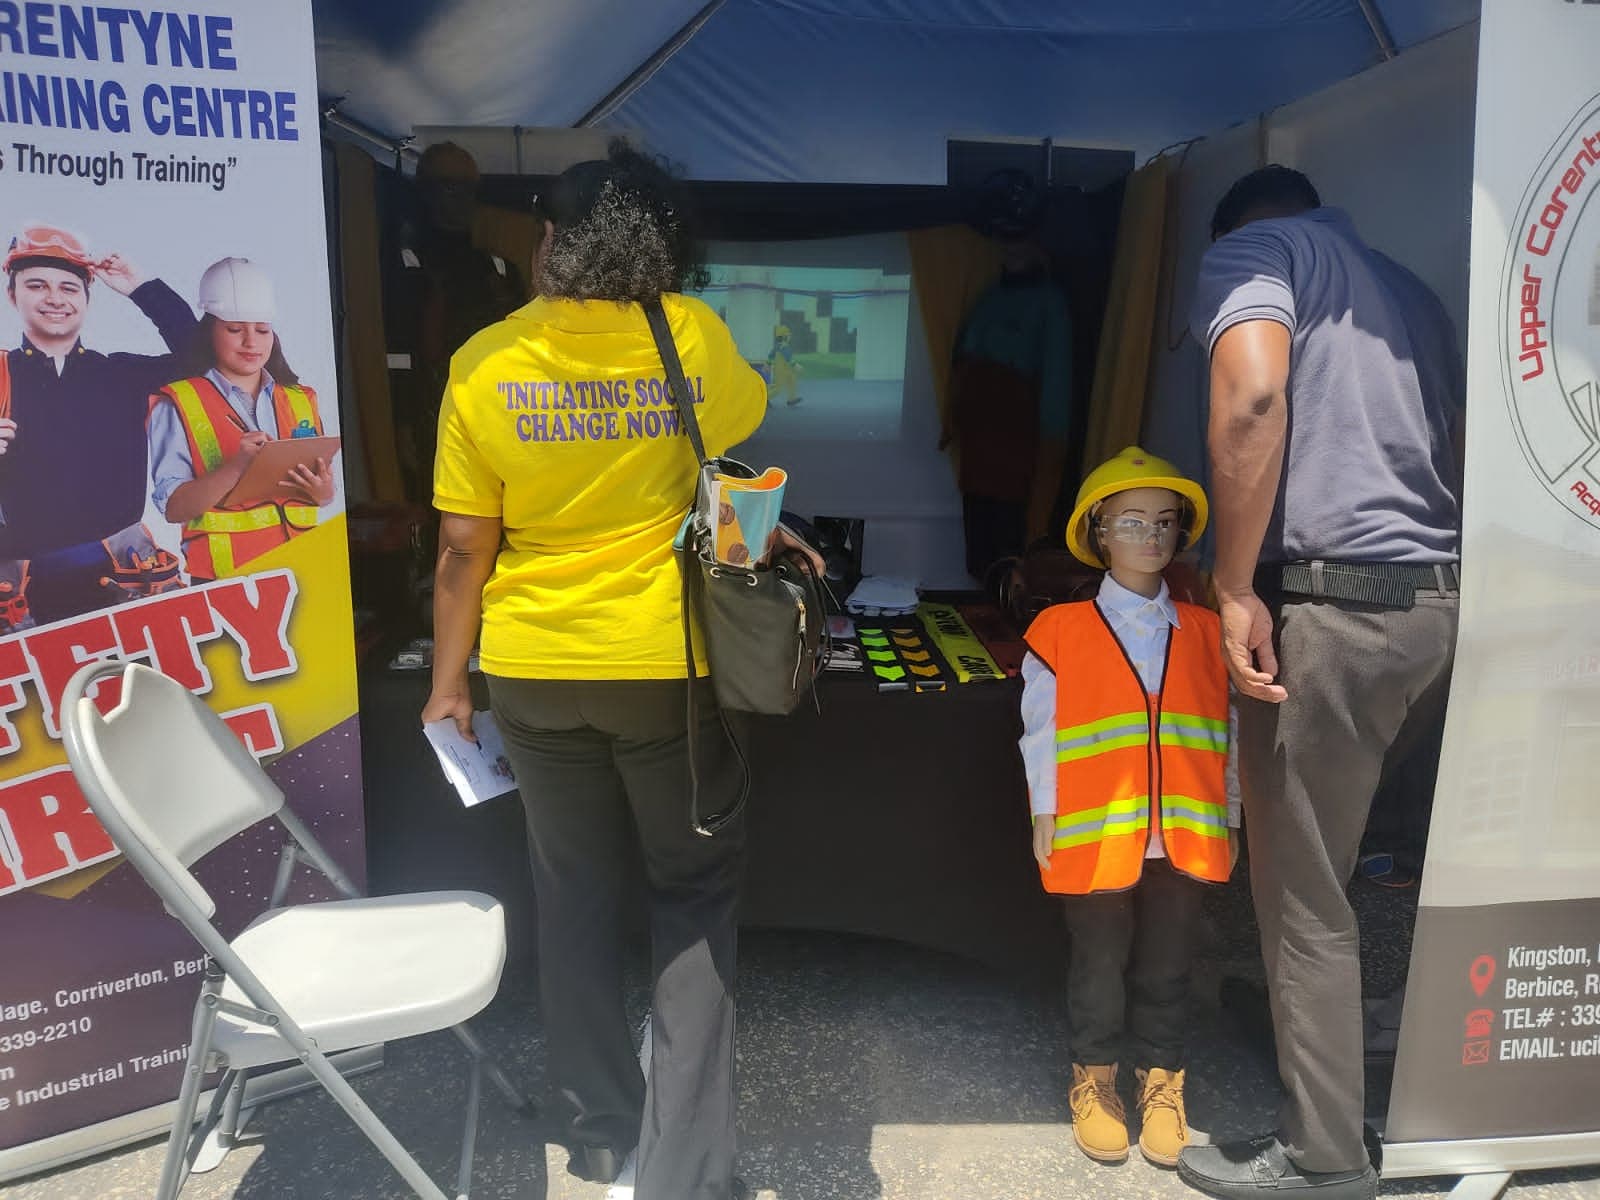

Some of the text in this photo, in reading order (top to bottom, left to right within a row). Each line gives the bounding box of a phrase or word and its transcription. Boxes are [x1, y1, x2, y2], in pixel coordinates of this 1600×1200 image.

[0, 1, 237, 70] RENTYNE
[0, 71, 299, 141] INING CENTRE
[12, 143, 123, 186] Through
[1526, 131, 1600, 256] Corent
[634, 376, 705, 407] SOCAL
[516, 412, 620, 442] CHANGE
[1570, 481, 1600, 516] Acq
[1507, 945, 1591, 970] Kingston,
[55, 968, 169, 1008] Corriverton,
[1504, 976, 1579, 999] Berbice,
[0, 1016, 92, 1053] 339-2210
[1502, 1007, 1554, 1030] TEL#
[1499, 1037, 1564, 1060] EMAIL:
[16, 1062, 124, 1106] Industrial
[129, 1043, 191, 1074] Traini
